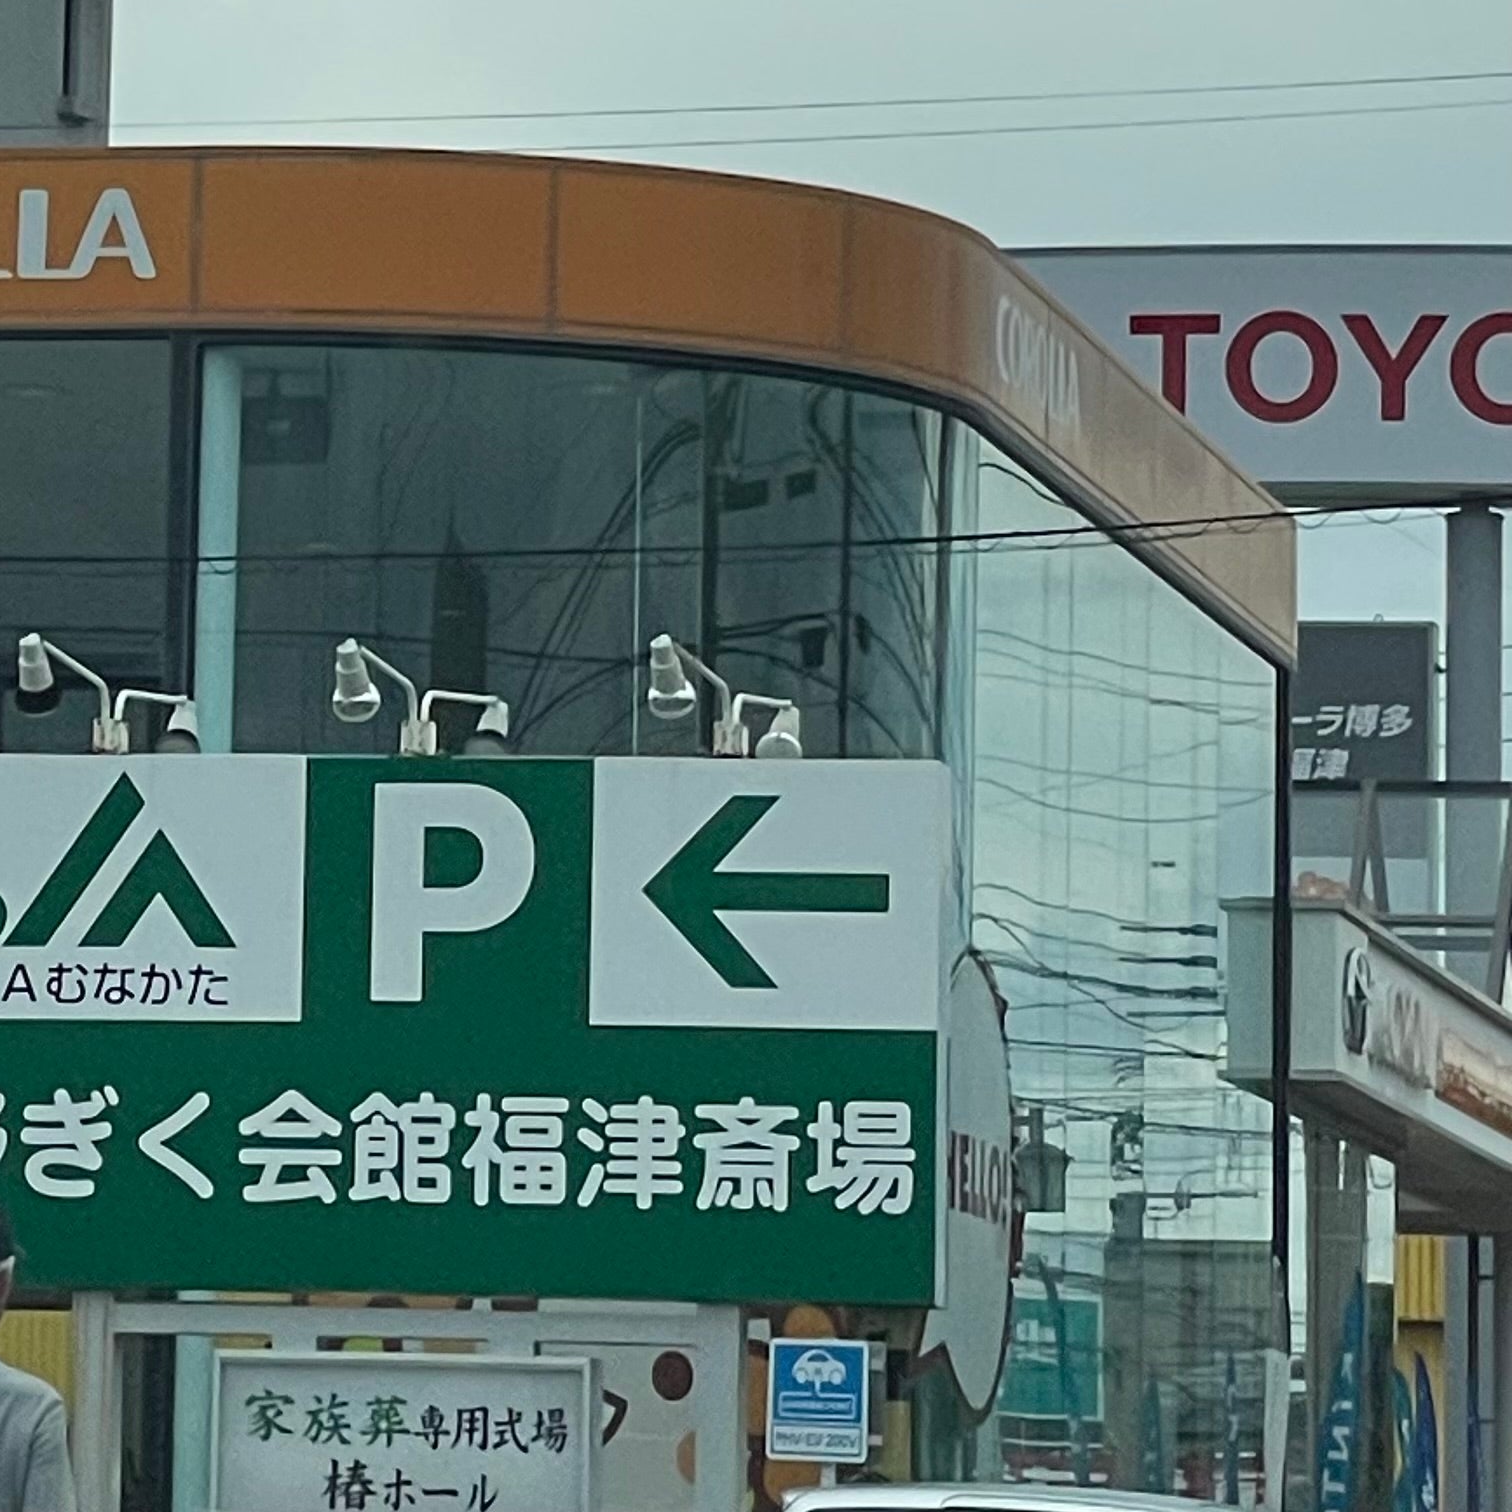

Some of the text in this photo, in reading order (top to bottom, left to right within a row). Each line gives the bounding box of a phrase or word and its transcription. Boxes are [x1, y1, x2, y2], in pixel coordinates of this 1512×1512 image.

[369, 782, 536, 1003] P
[244, 1388, 569, 1455] 家族葬専用式場
[321, 1458, 500, 1512] 椿ホール
